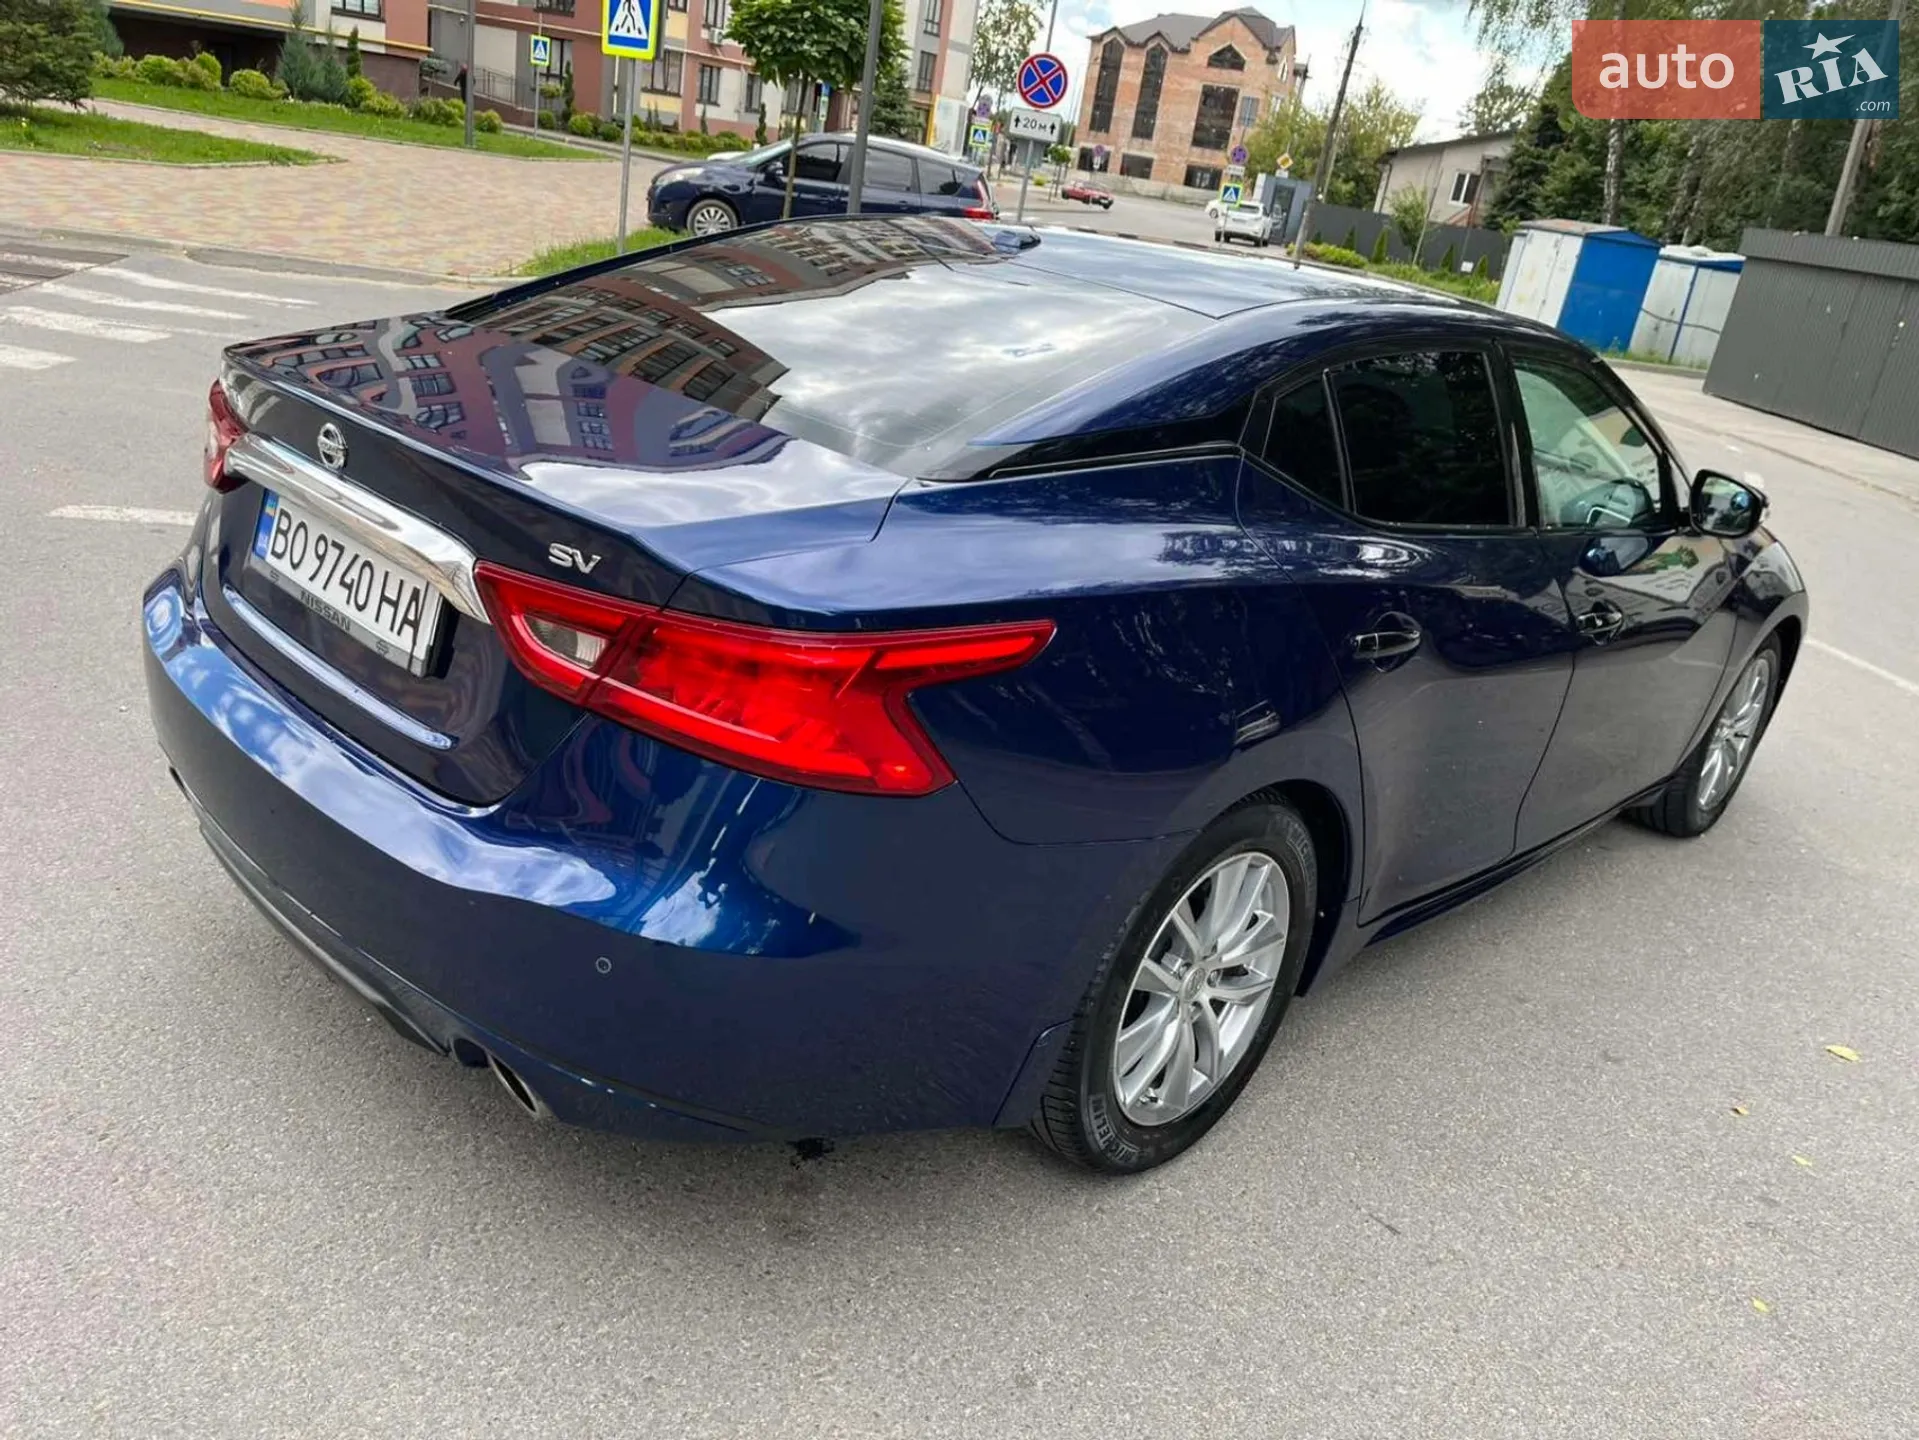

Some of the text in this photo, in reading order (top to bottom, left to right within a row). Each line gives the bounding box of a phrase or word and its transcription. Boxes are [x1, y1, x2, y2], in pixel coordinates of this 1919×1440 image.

[270, 507, 422, 641] BO 9740 HA
[548, 542, 602, 574] SV
[300, 589, 351, 634] NISSAN
